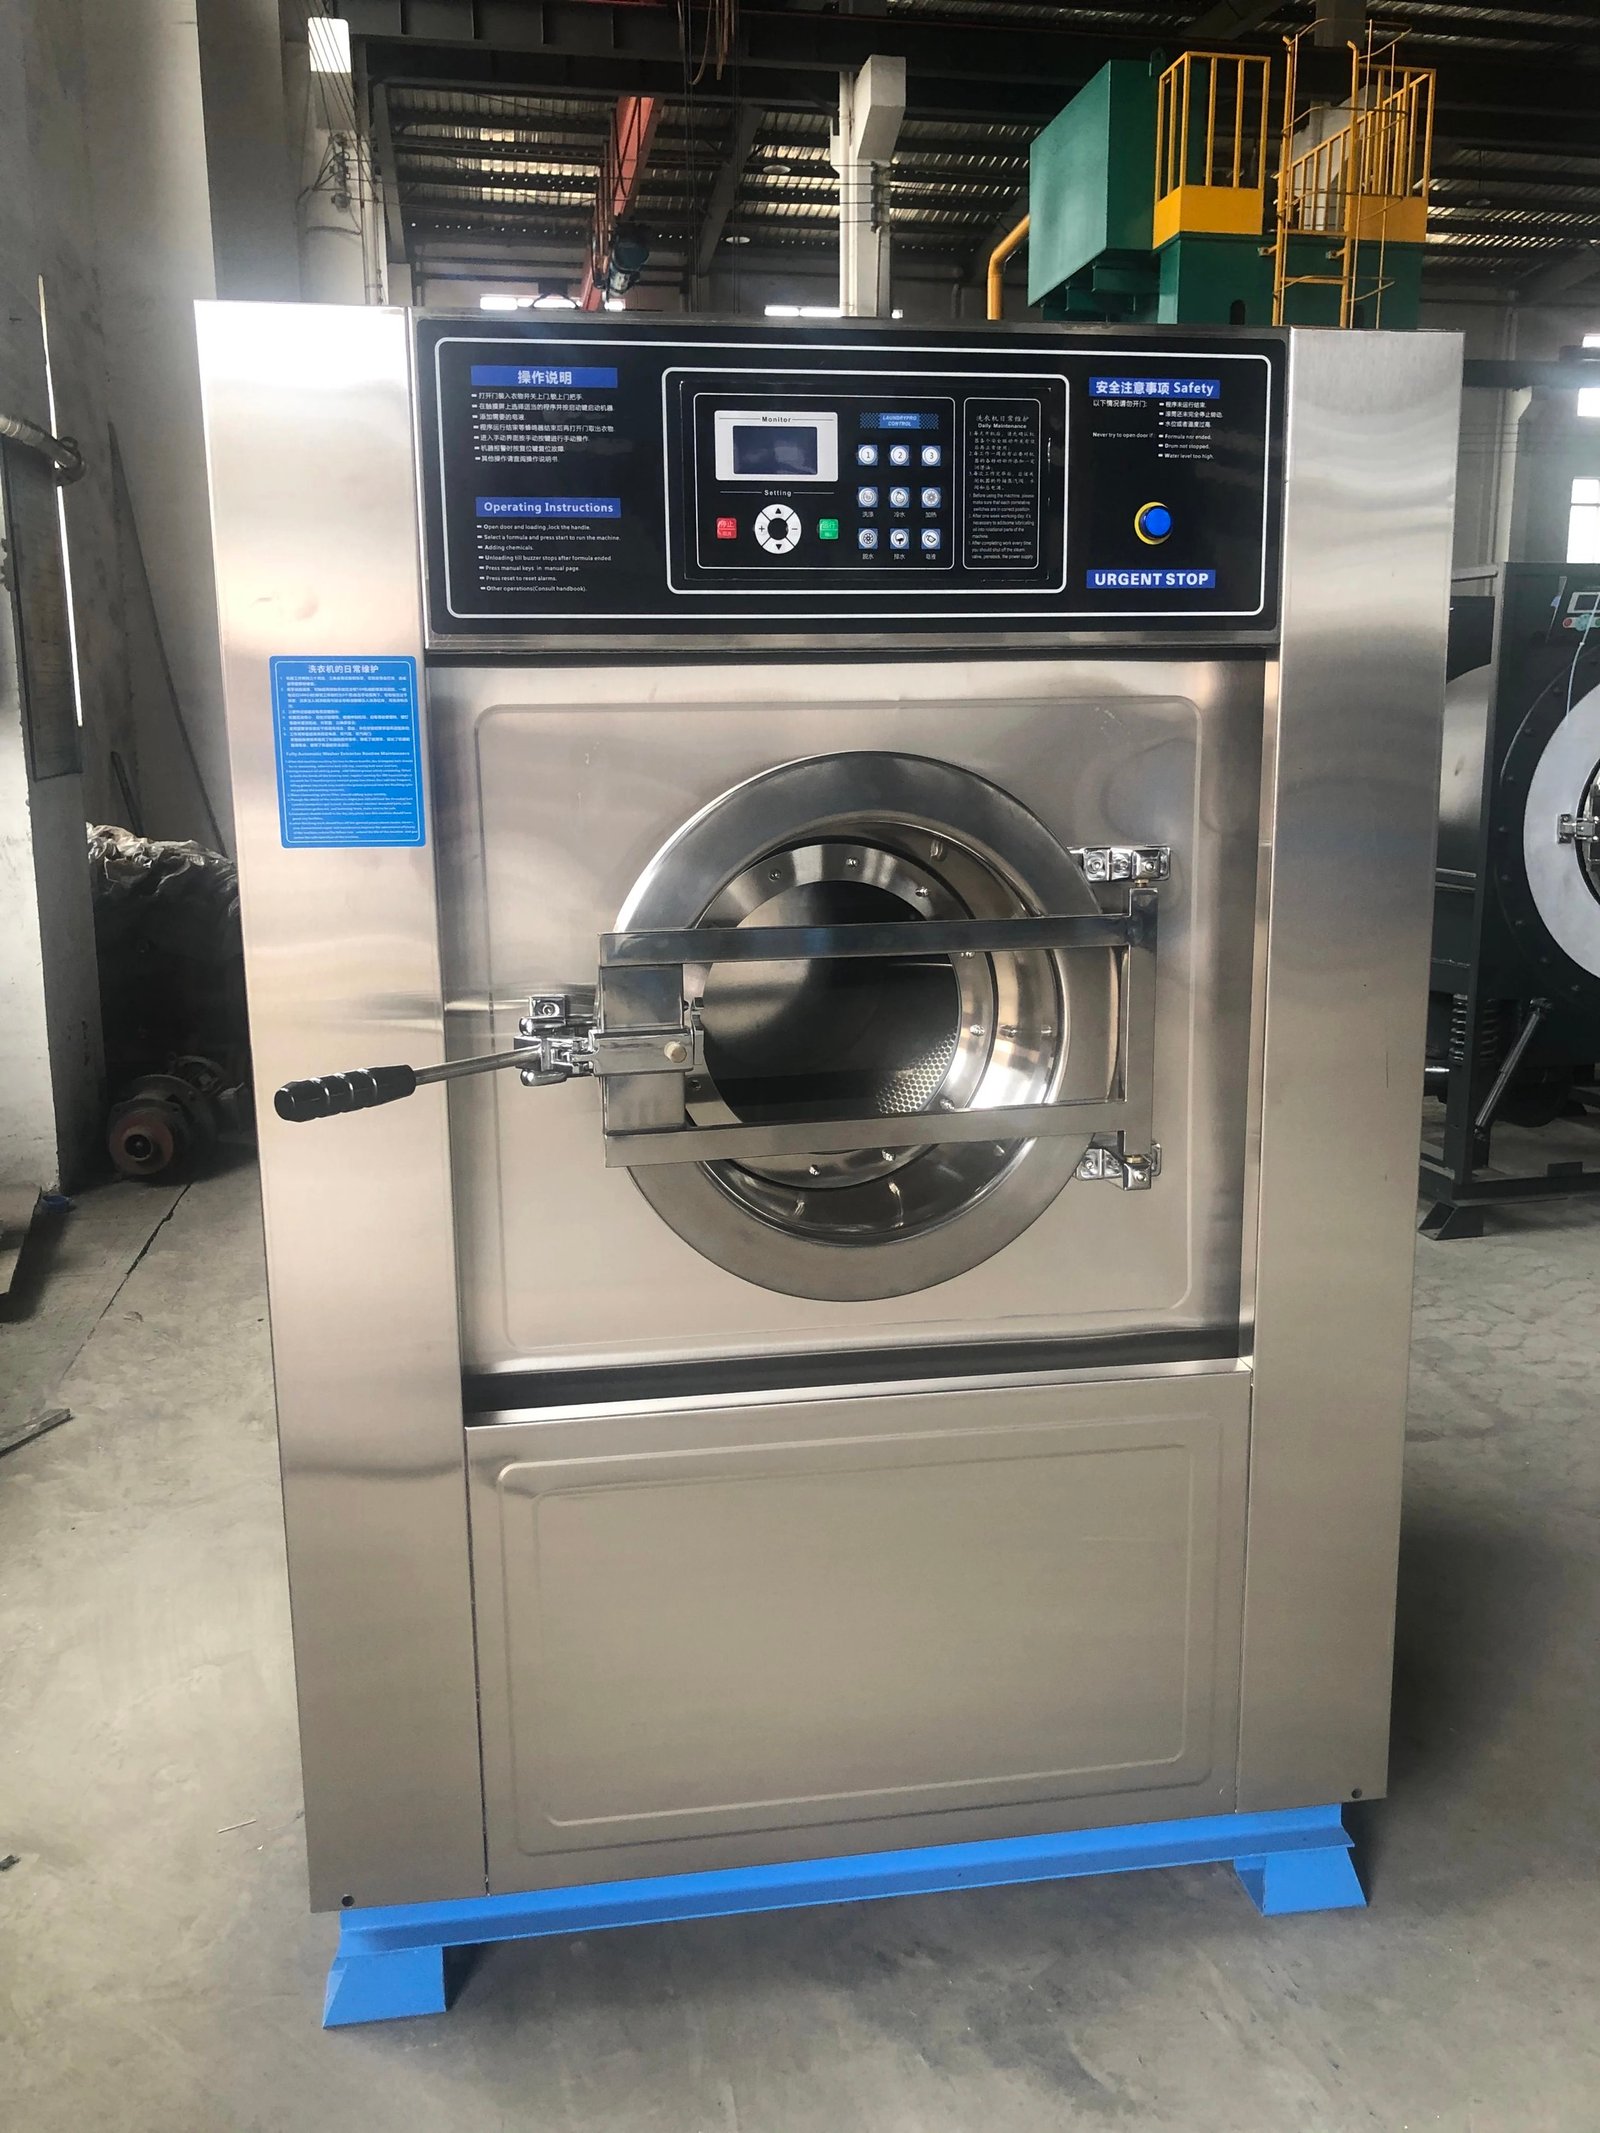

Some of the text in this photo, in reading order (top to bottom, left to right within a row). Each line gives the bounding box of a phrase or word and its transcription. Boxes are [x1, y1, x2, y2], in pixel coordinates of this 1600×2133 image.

[517, 370, 572, 385] 操作说明
[1095, 381, 1214, 396] 安全注意事项 Safety
[484, 502, 614, 514] Operating Instructions
[1095, 573, 1209, 586] URGENT STOP
[308, 664, 379, 674] 洗衣机的日常维护
